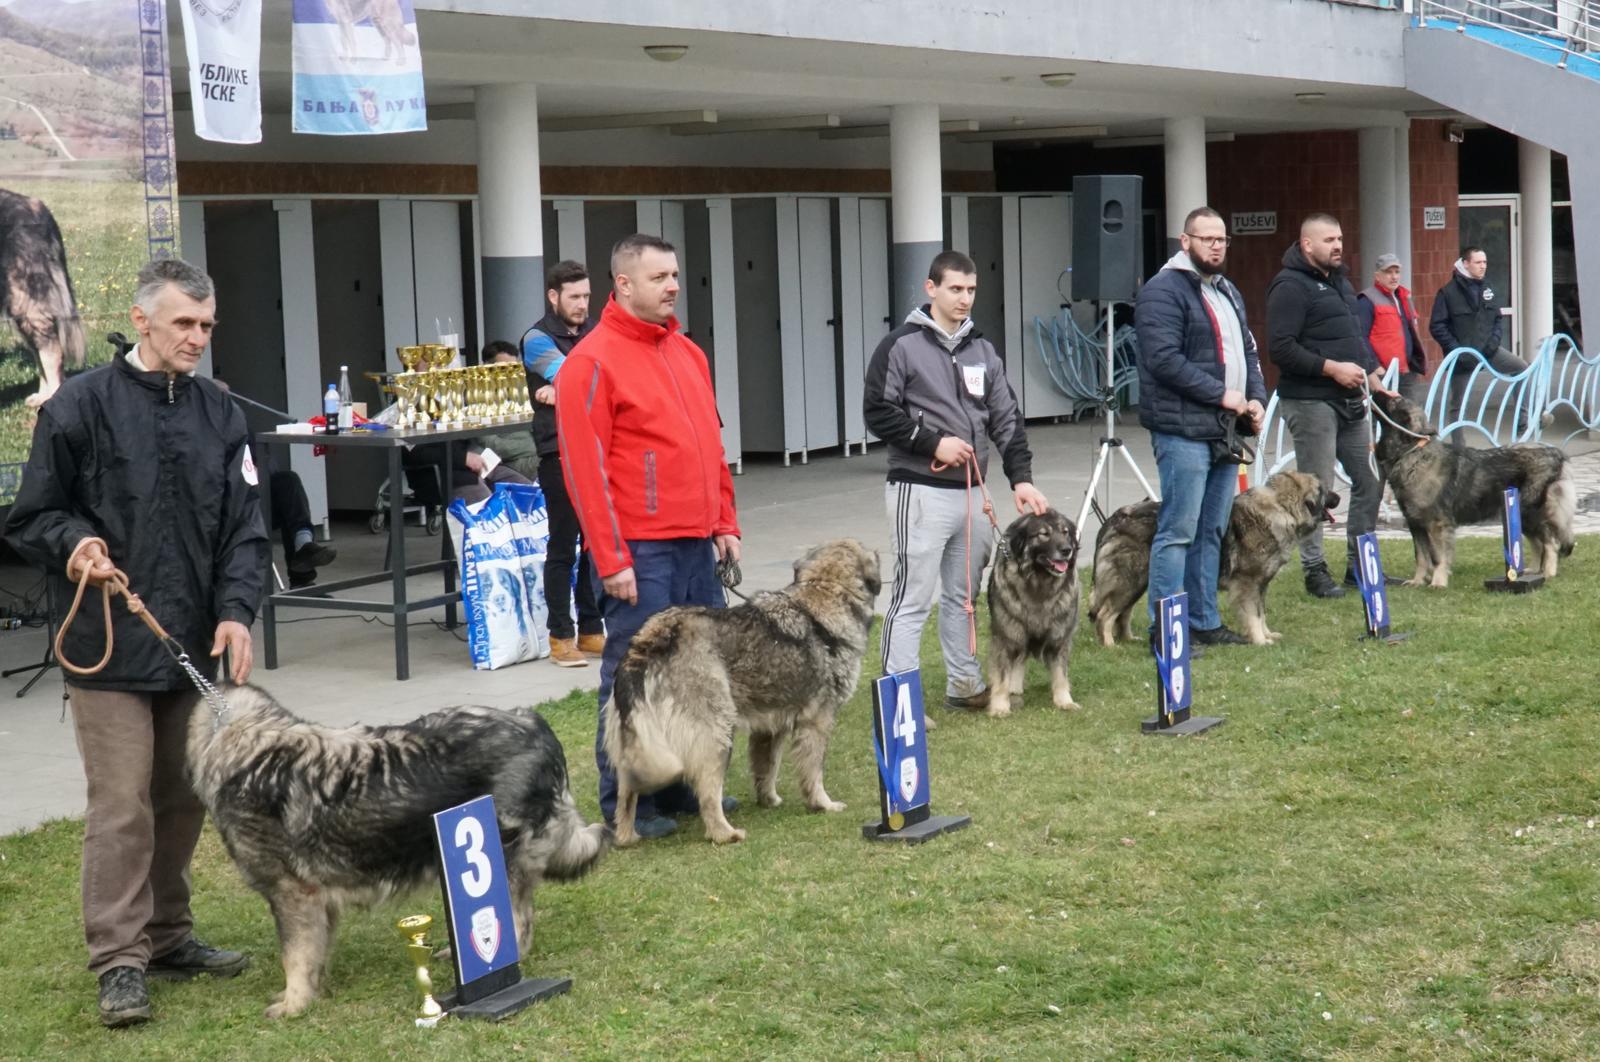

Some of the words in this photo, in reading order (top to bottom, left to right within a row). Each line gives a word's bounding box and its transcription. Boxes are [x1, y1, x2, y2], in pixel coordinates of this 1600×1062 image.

[1233, 214, 1276, 227] TUŠEVI
[1364, 541, 1379, 586] 6
[1168, 604, 1184, 660] 5
[893, 683, 917, 747] 4
[455, 816, 492, 898] 3
